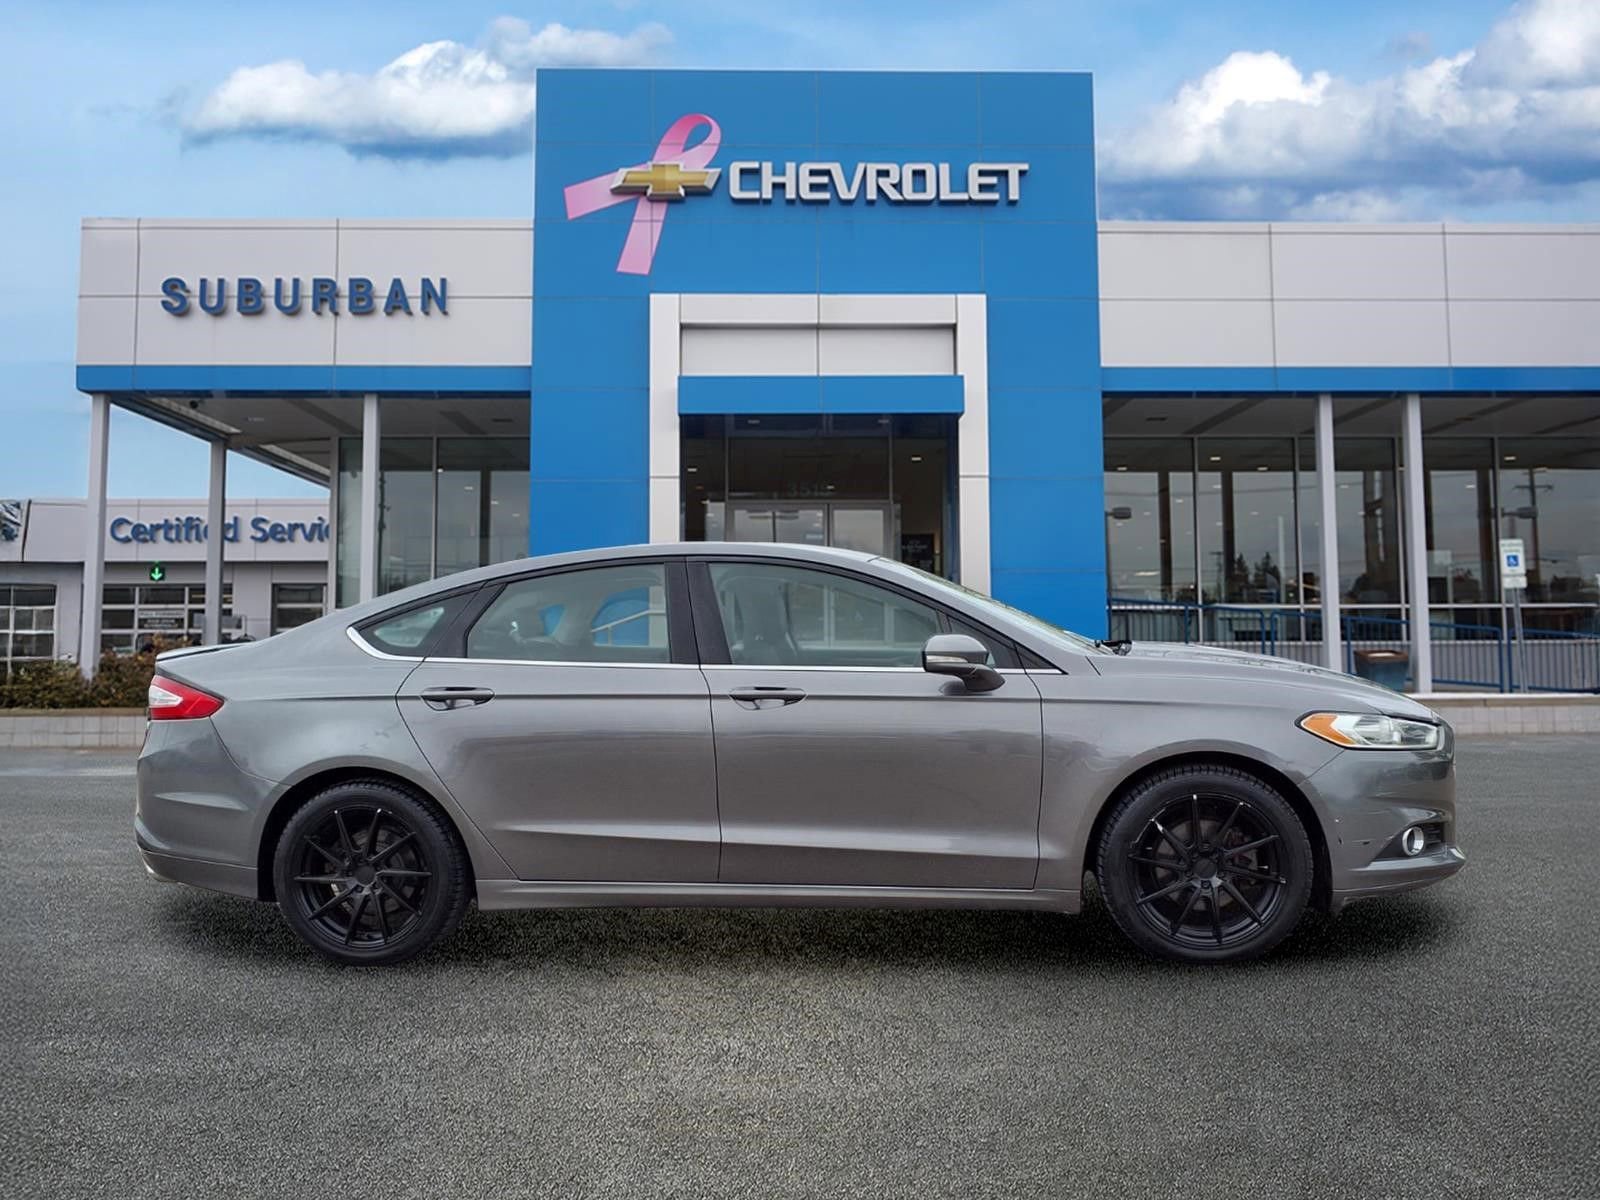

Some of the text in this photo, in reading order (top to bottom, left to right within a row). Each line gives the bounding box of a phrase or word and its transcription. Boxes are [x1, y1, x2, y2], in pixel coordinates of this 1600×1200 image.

[729, 161, 1029, 202] CHEVROLET
[161, 277, 449, 315] SUBURBAN
[110, 516, 330, 543] Certifid Servi
